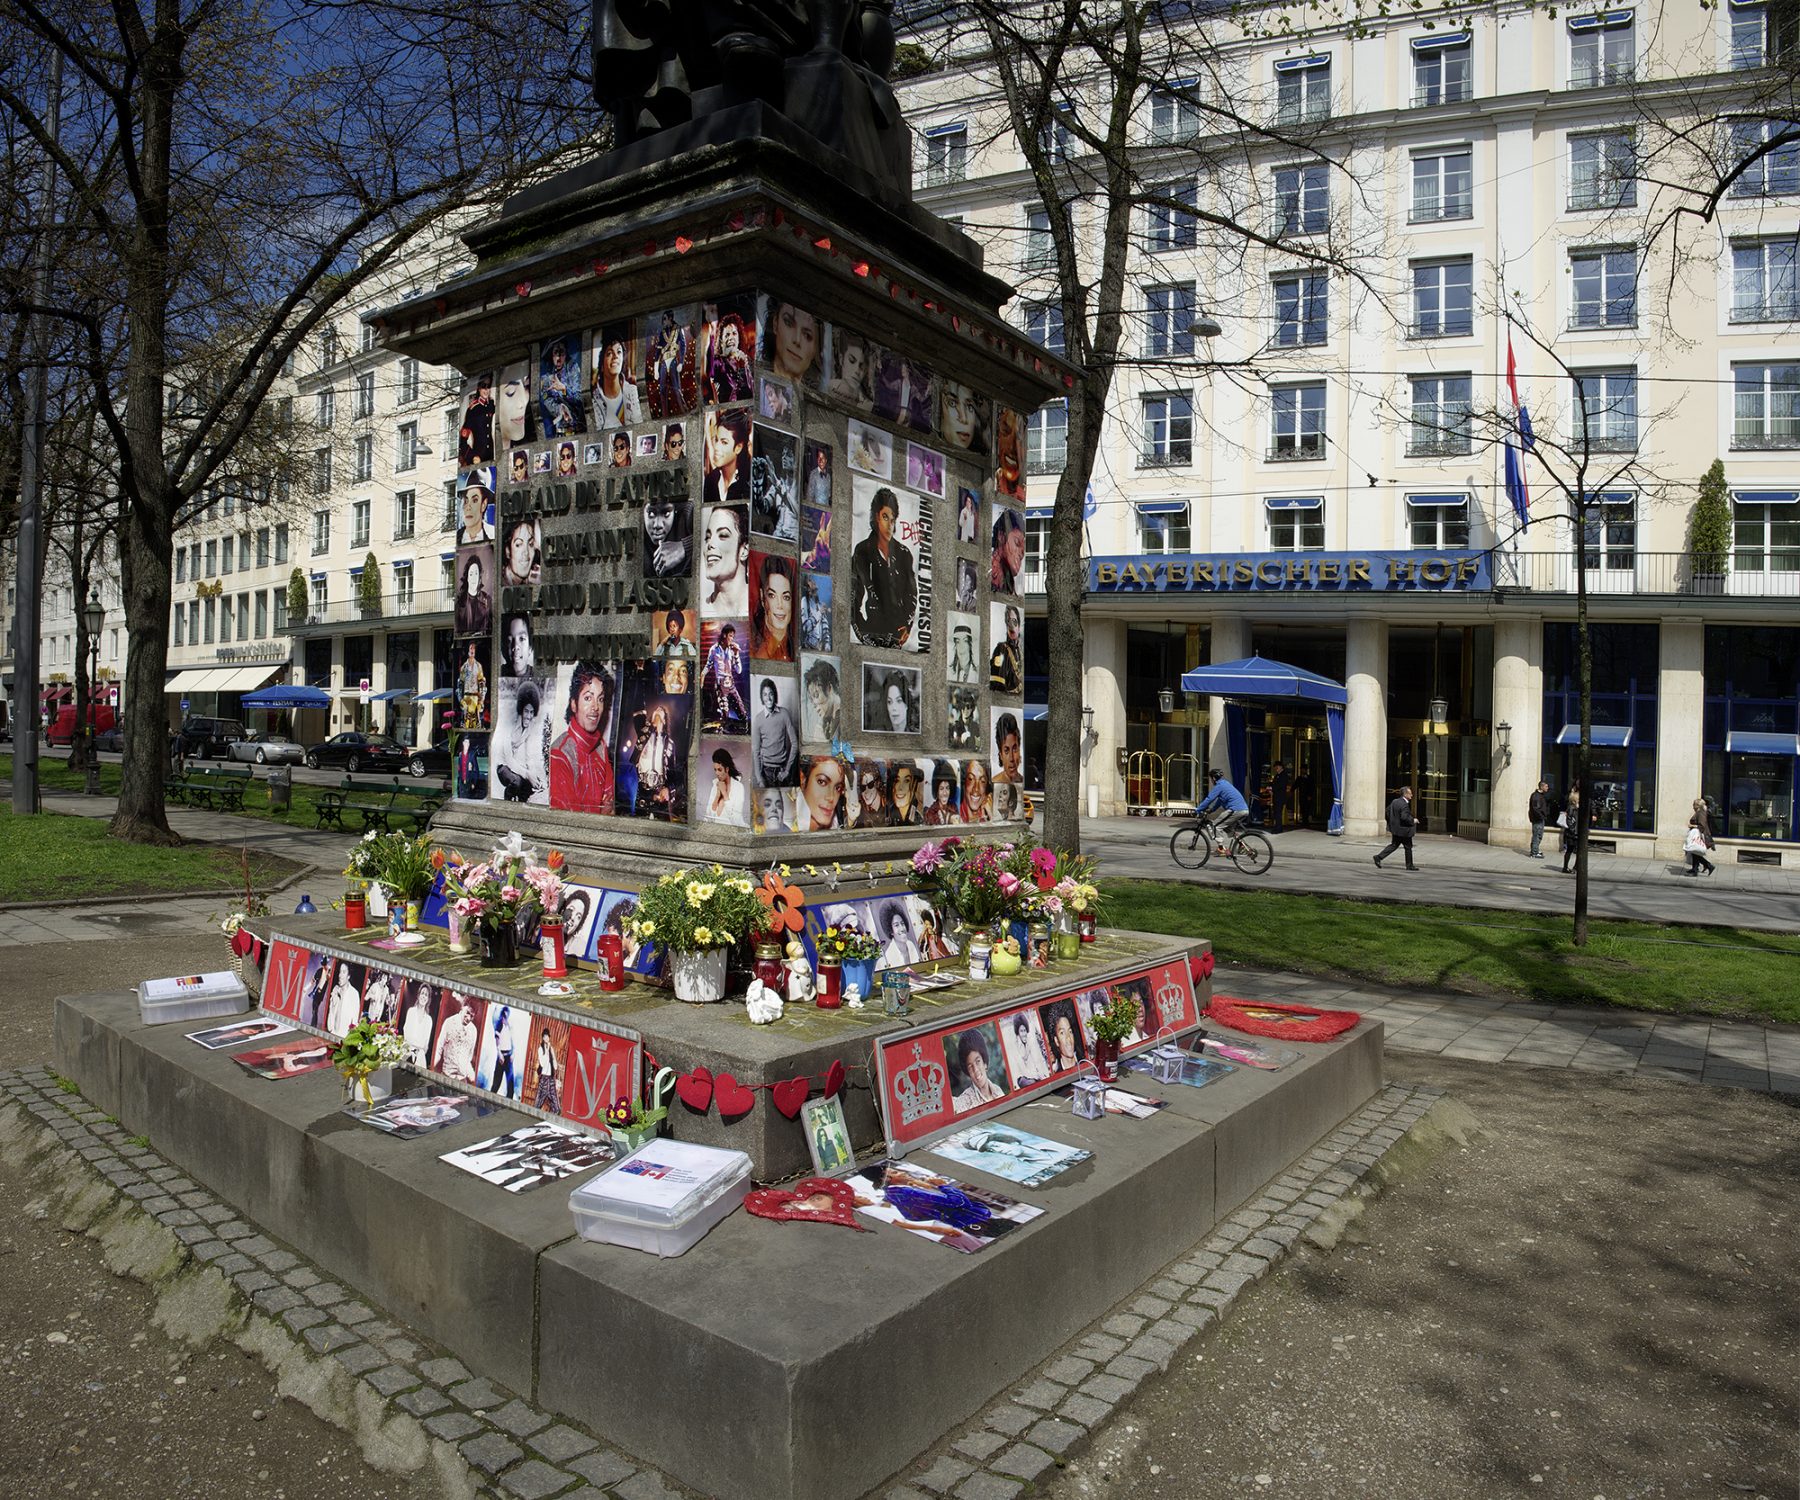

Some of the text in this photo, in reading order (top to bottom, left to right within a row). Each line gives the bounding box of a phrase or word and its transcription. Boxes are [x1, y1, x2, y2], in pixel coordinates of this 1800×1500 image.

[575, 479, 601, 508] DE
[917, 497, 934, 654] MICHAEL JACKSON
[1098, 556, 1481, 585] BAYERISCHER HOF
[588, 581, 610, 609] DI
[613, 577, 689, 608] LASSO
